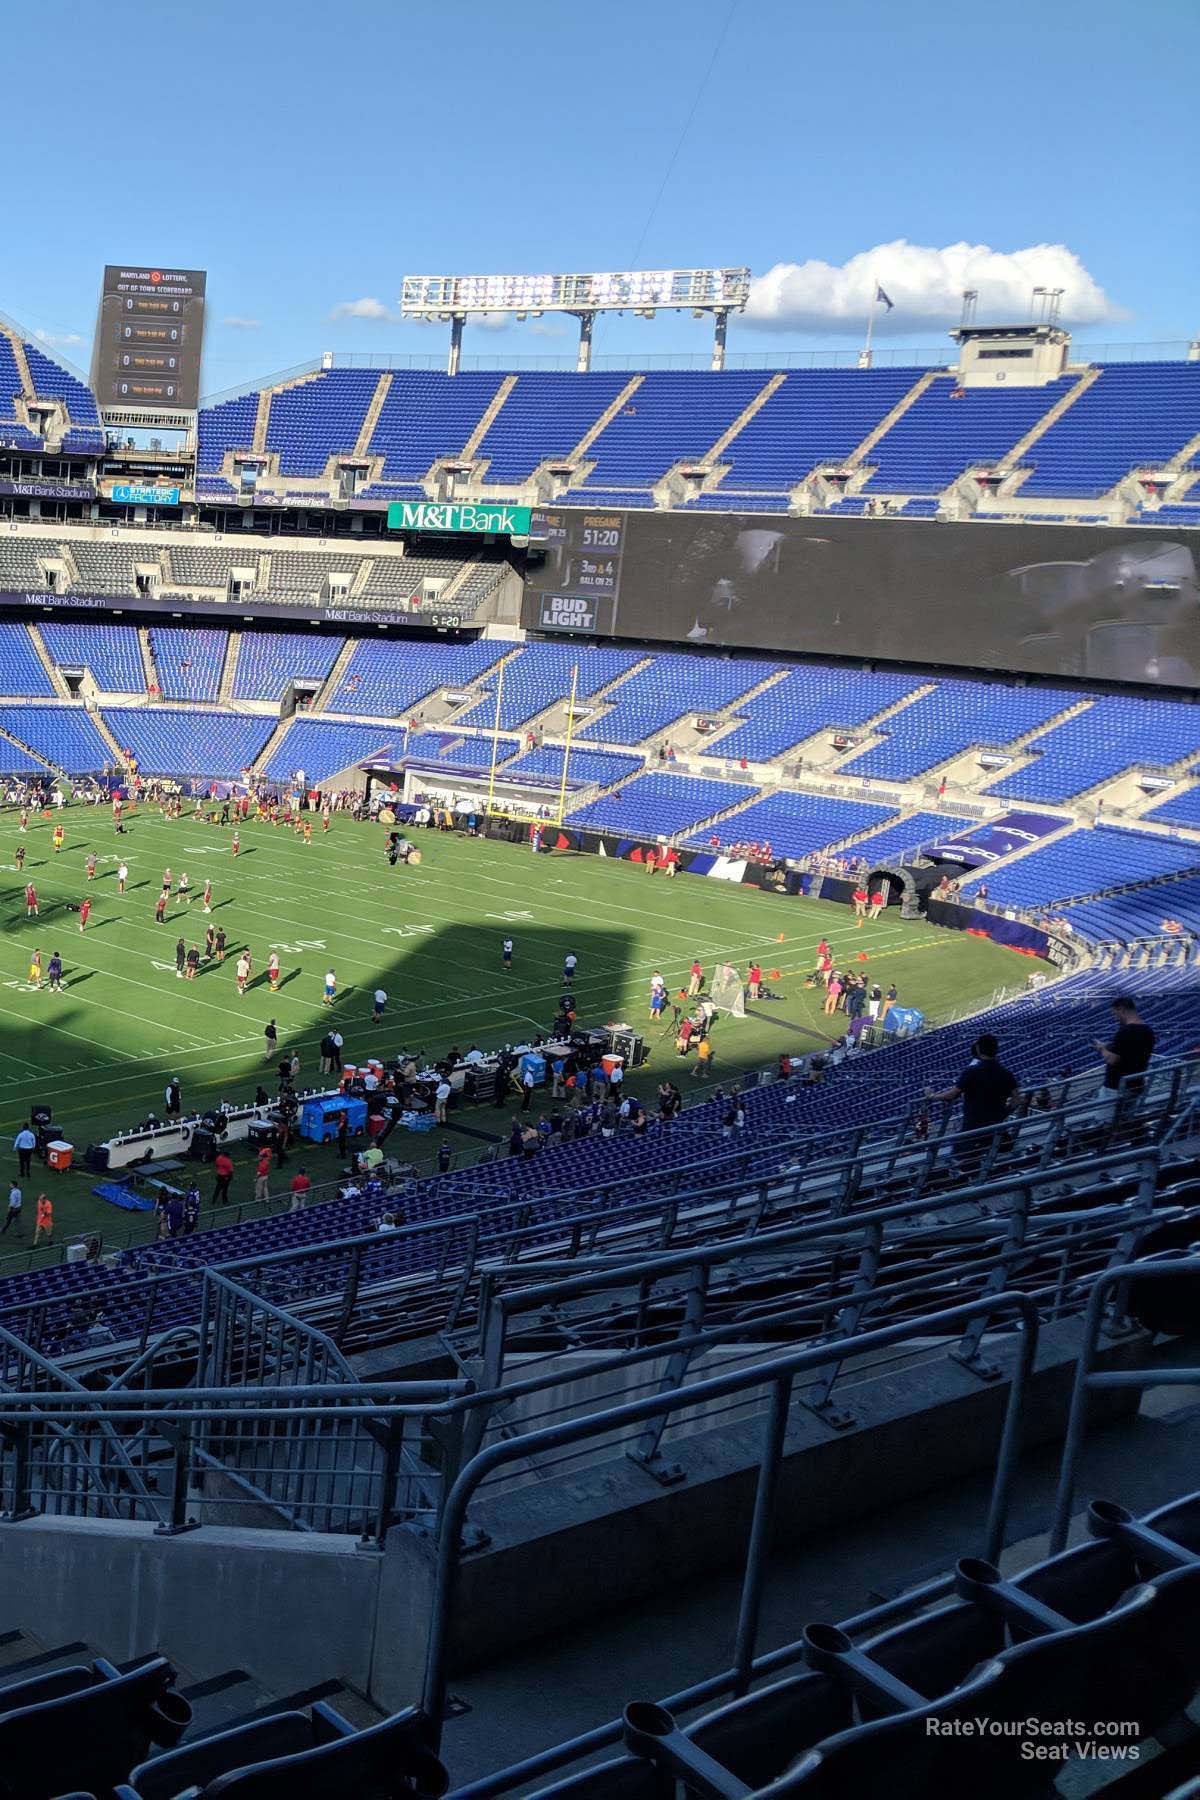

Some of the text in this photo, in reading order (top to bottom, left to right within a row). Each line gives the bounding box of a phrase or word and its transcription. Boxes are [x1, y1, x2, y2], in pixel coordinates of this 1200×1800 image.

[120, 271, 150, 280] MARYLAND
[13, 484, 90, 499] M&T Bank Stadium
[402, 502, 459, 529] M&T
[460, 507, 516, 532] Bank
[583, 515, 621, 528] PREGAME
[583, 529, 619, 546] 51:20
[605, 561, 613, 575] 4
[25, 594, 106, 608] M&T Bank Stadium
[551, 597, 588, 613] BUD
[325, 609, 408, 625] M&T Bank Stadium
[543, 610, 594, 627] LIGHT
[49, 1151, 59, 1164] G
